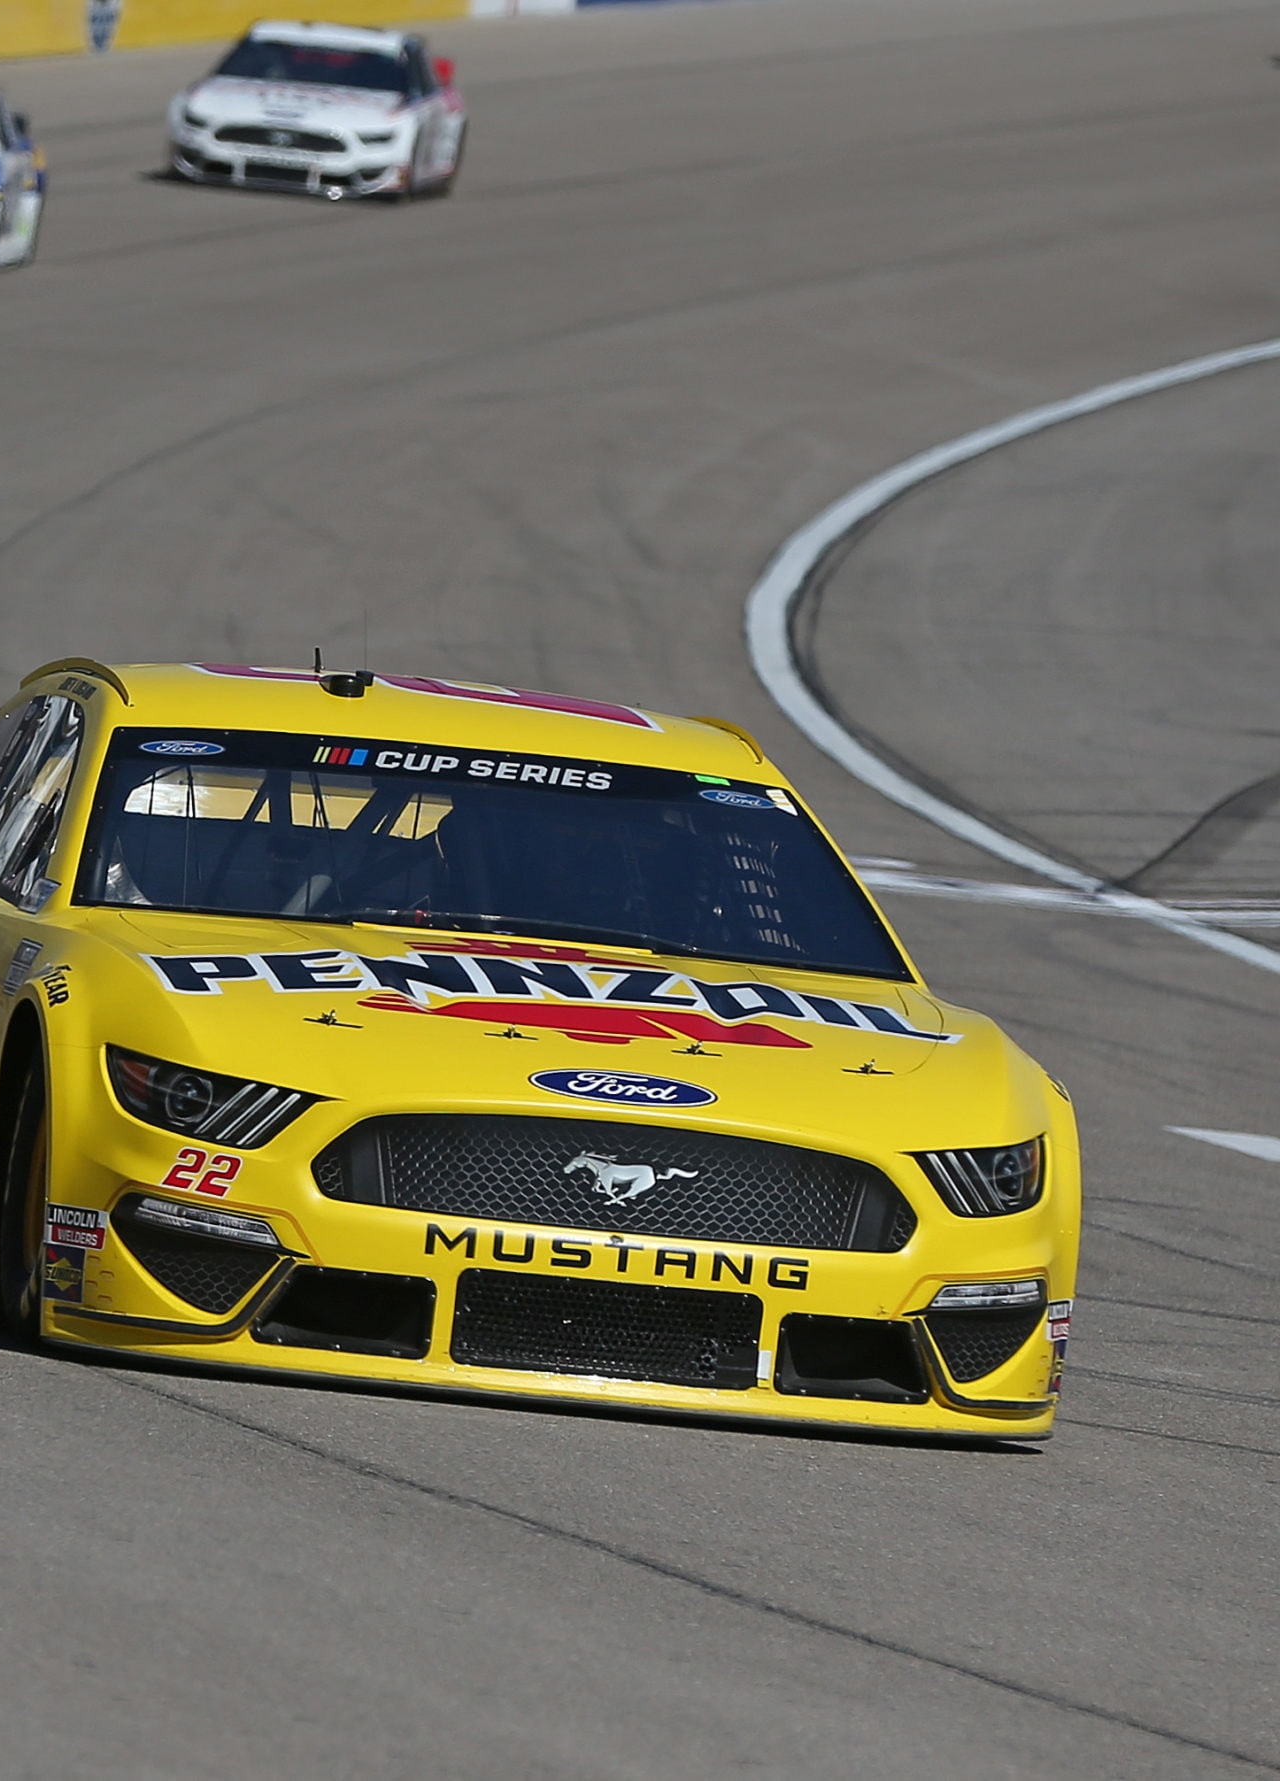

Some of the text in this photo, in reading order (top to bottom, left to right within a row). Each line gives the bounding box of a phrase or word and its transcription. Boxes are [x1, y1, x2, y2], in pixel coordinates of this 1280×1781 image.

[156, 741, 208, 755] Ford
[374, 750, 613, 790] CUP SERIES
[140, 950, 962, 1045] PENNZOIL
[567, 1072, 678, 1101] Ford
[160, 1146, 244, 1199] 22
[47, 1205, 97, 1229] LINCOLN
[56, 1227, 99, 1247] WELDERS
[424, 1222, 810, 1291] MUSTANG
